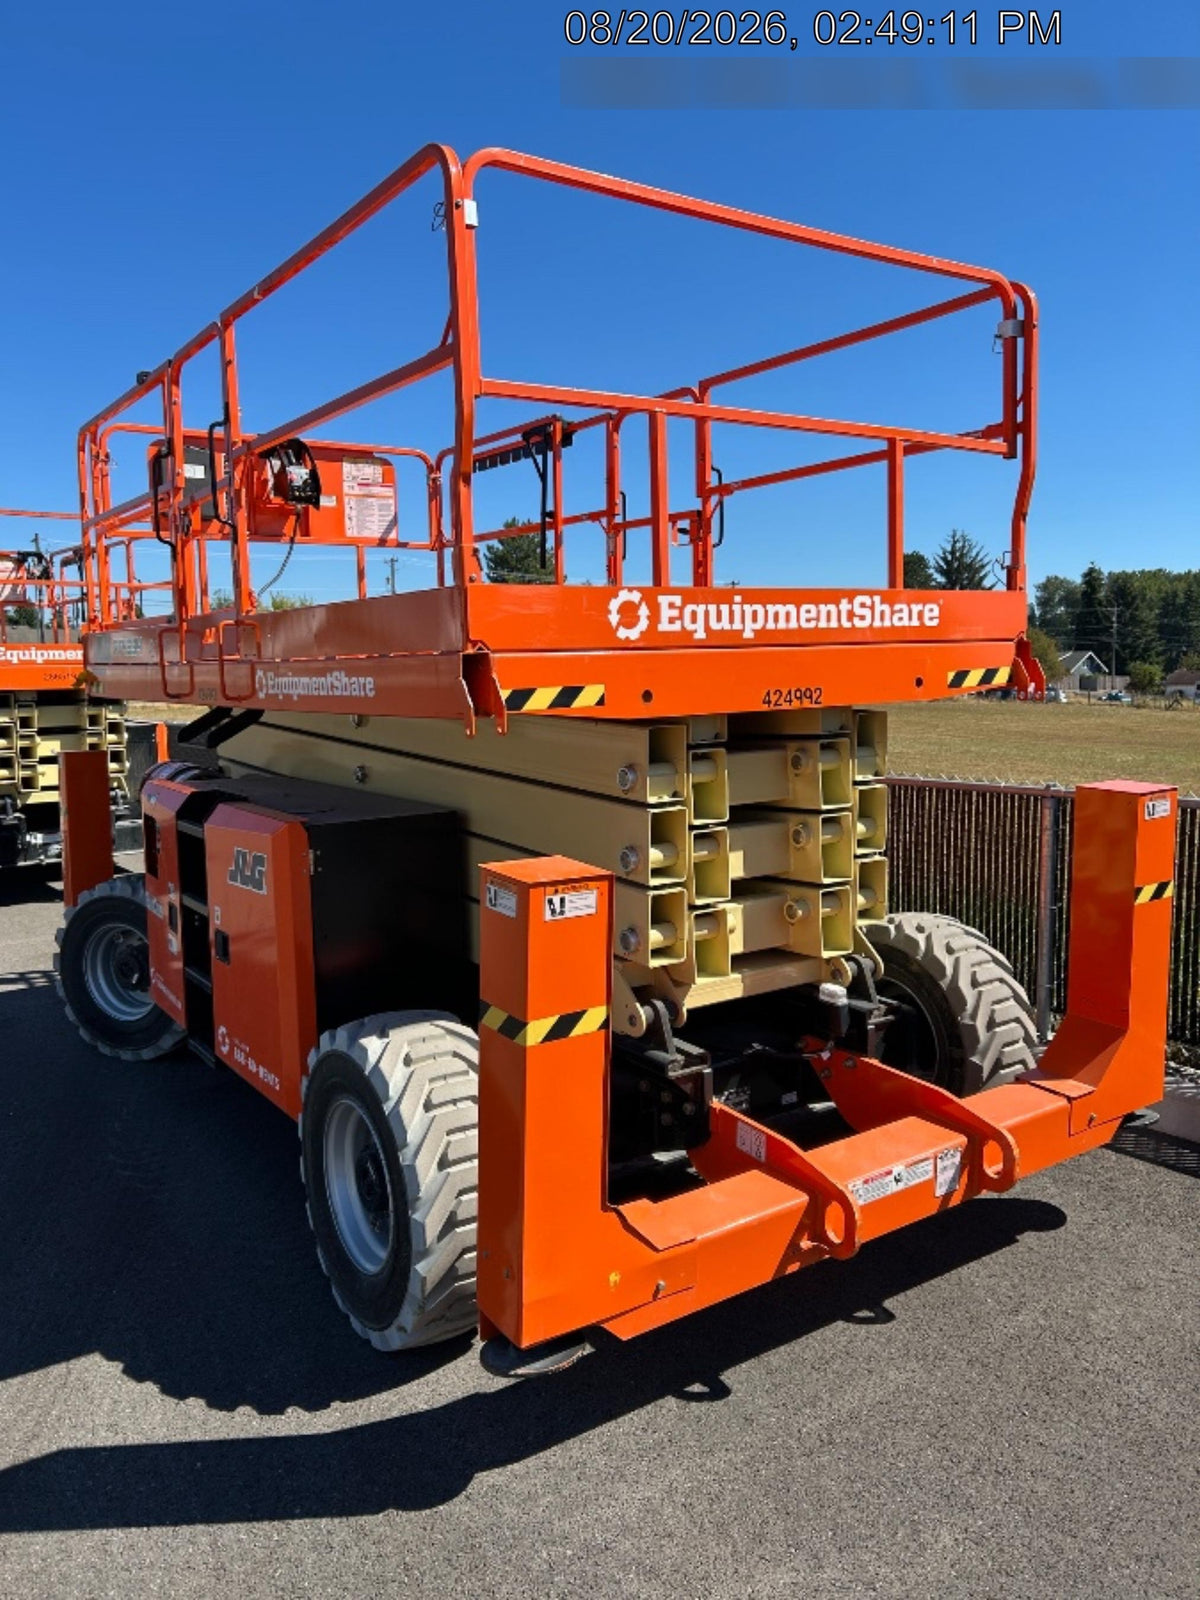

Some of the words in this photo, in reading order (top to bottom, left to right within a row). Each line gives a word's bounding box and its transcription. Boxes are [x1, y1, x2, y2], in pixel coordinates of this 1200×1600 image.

[657, 595, 940, 639] EquipmentShare
[266, 670, 376, 701] EquipmentShare
[762, 687, 823, 708] 424992
[227, 846, 267, 895] JLG
